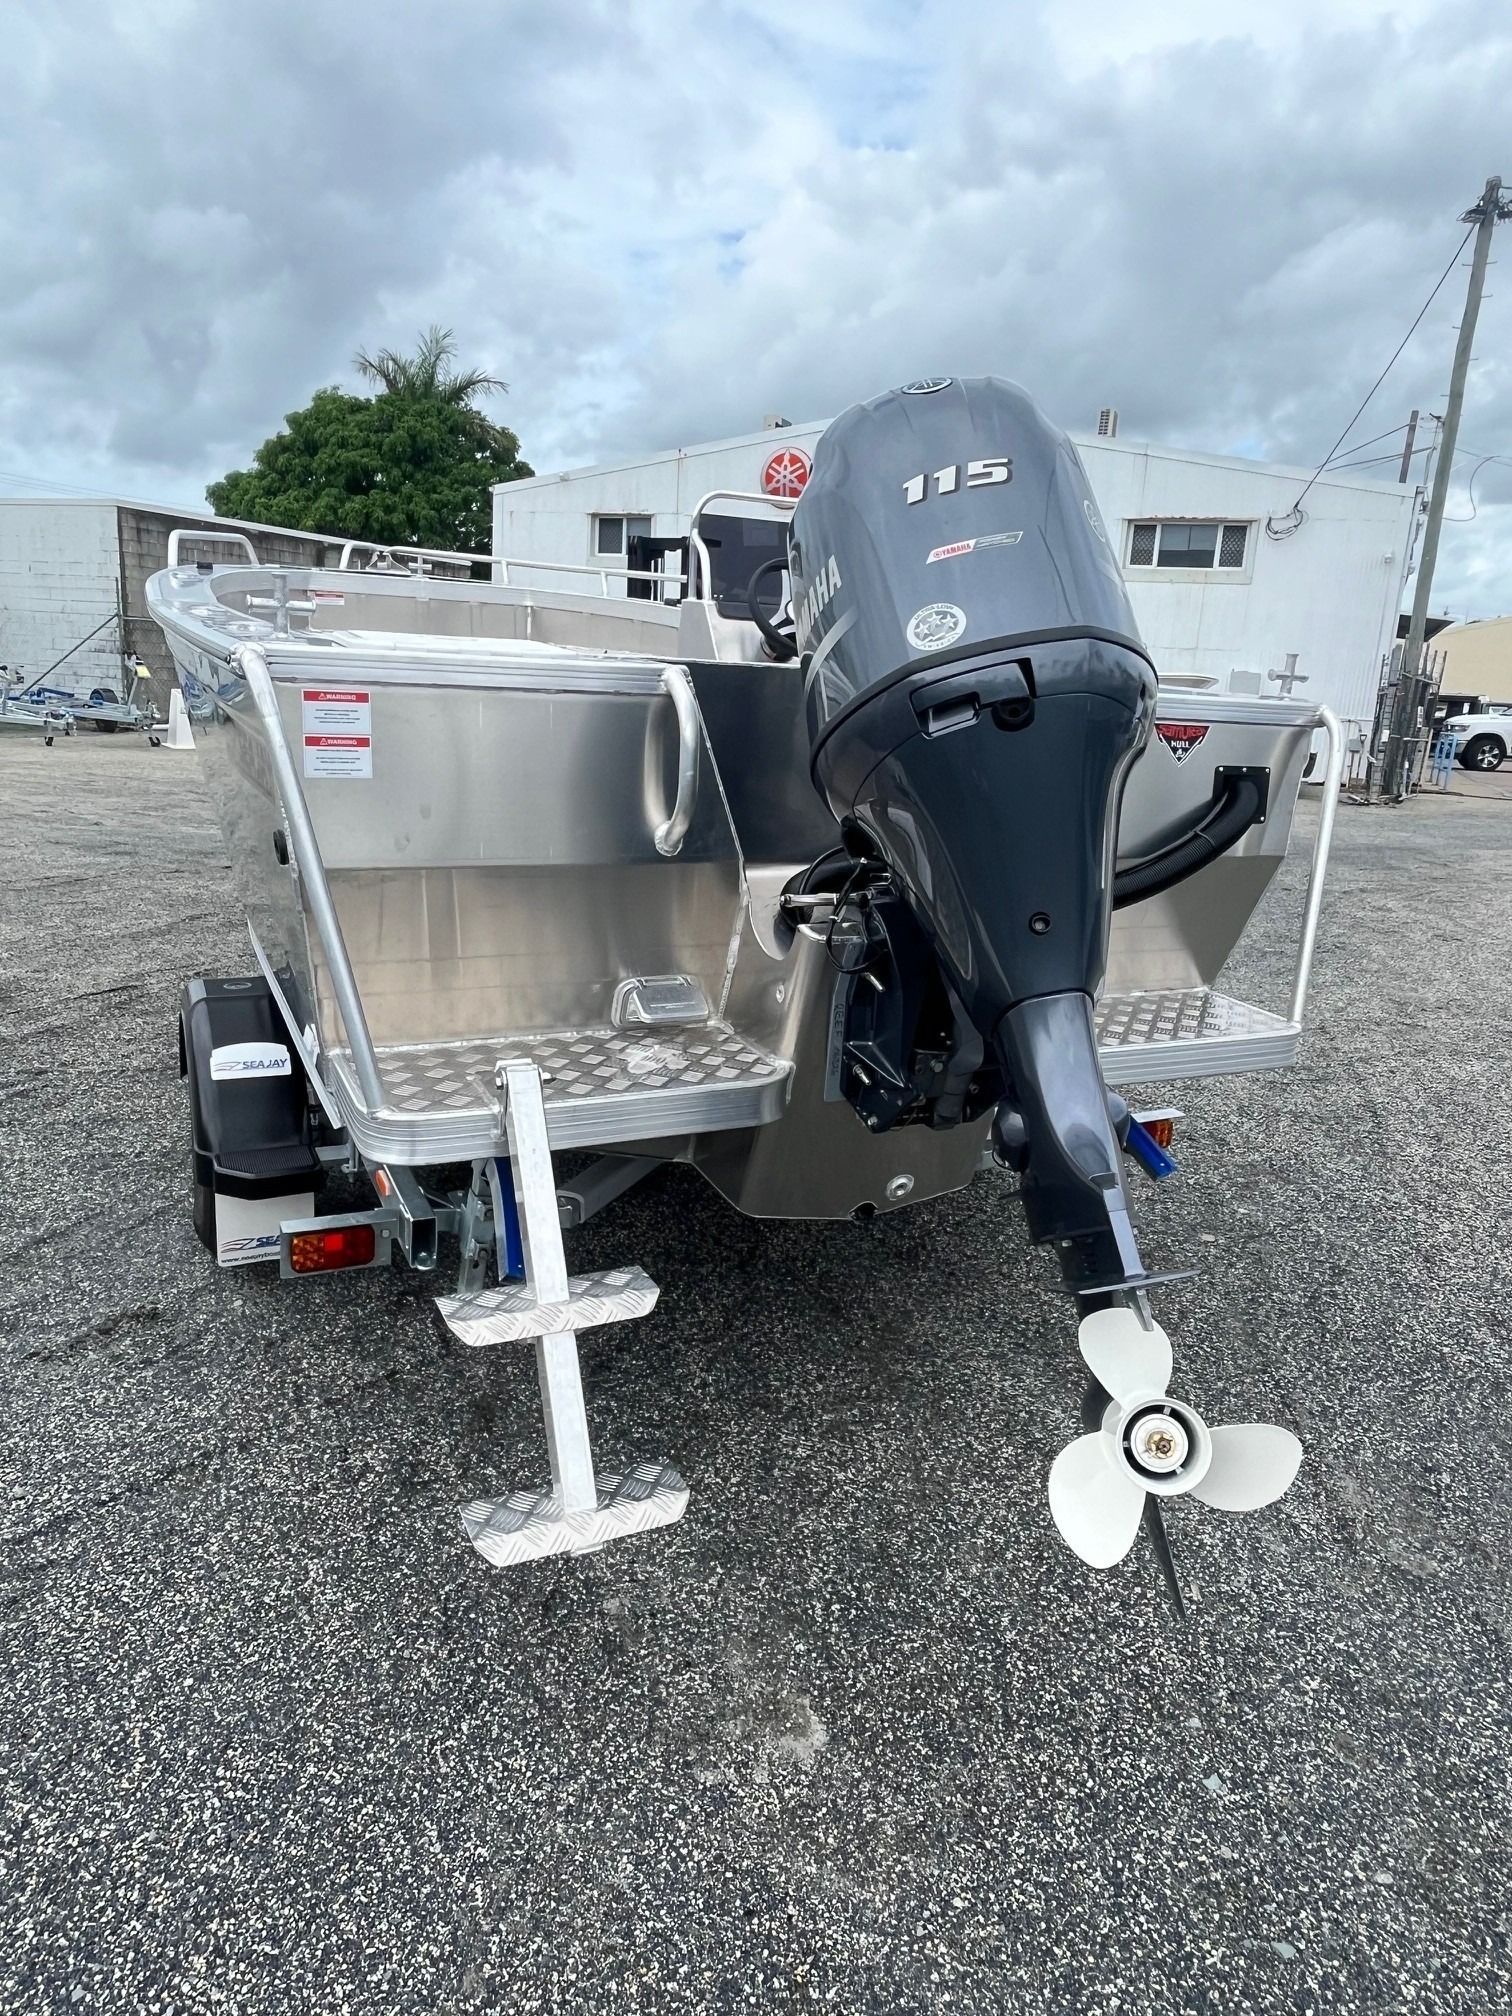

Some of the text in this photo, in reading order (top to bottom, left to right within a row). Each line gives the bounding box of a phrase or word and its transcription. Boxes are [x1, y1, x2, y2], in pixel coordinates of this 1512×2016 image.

[903, 458, 1011, 505] 115
[942, 543, 972, 557] YAMAHA
[327, 738, 358, 746] WARNING
[1170, 740, 1190, 748] HULL
[243, 1059, 287, 1069] SEA JAY
